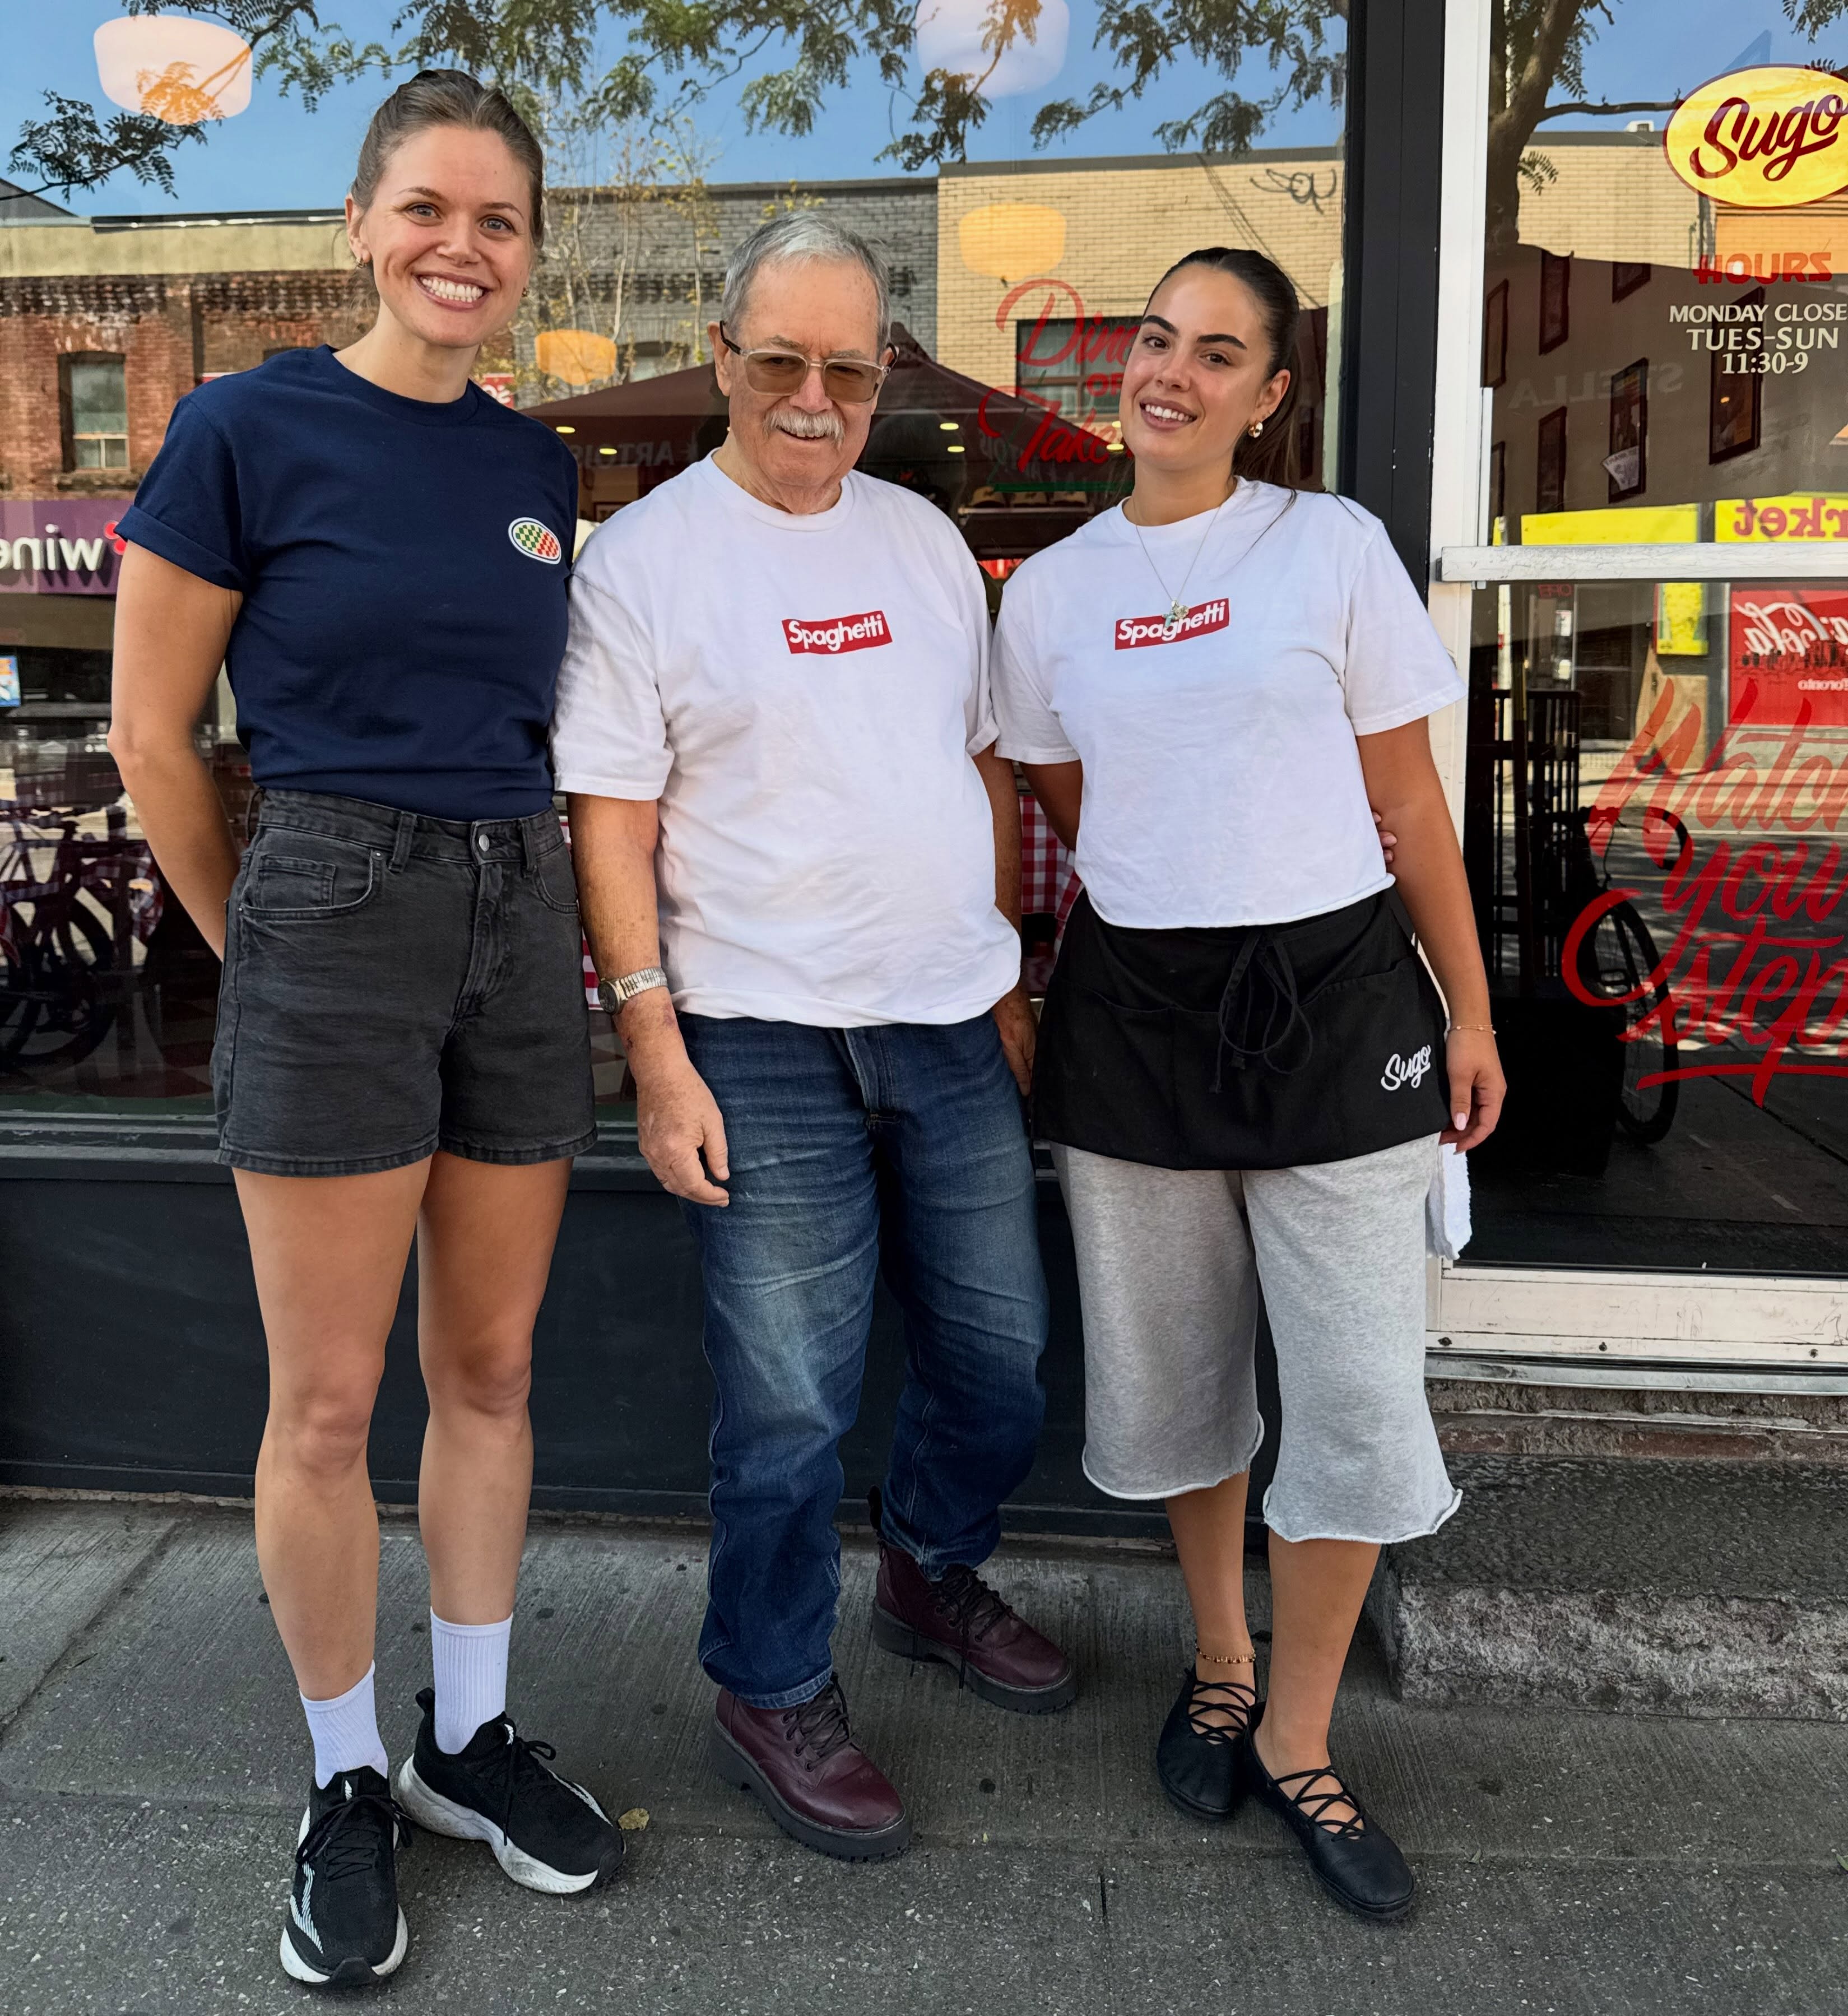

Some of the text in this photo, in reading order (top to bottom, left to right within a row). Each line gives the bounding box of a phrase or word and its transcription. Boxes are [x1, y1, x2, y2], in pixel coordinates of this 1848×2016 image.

[1689, 94, 1848, 182] Sugo
[1693, 252, 1833, 285] HOURS
[1669, 303, 1848, 323] MONDAY CLOSE
[1686, 327, 1838, 351] TUES-SUN
[1722, 351, 1809, 374] 11:30-9
[788, 614, 884, 652] Spaghetti
[1117, 601, 1226, 645] Spaghetti
[1380, 1044, 1432, 1091] Sugo
